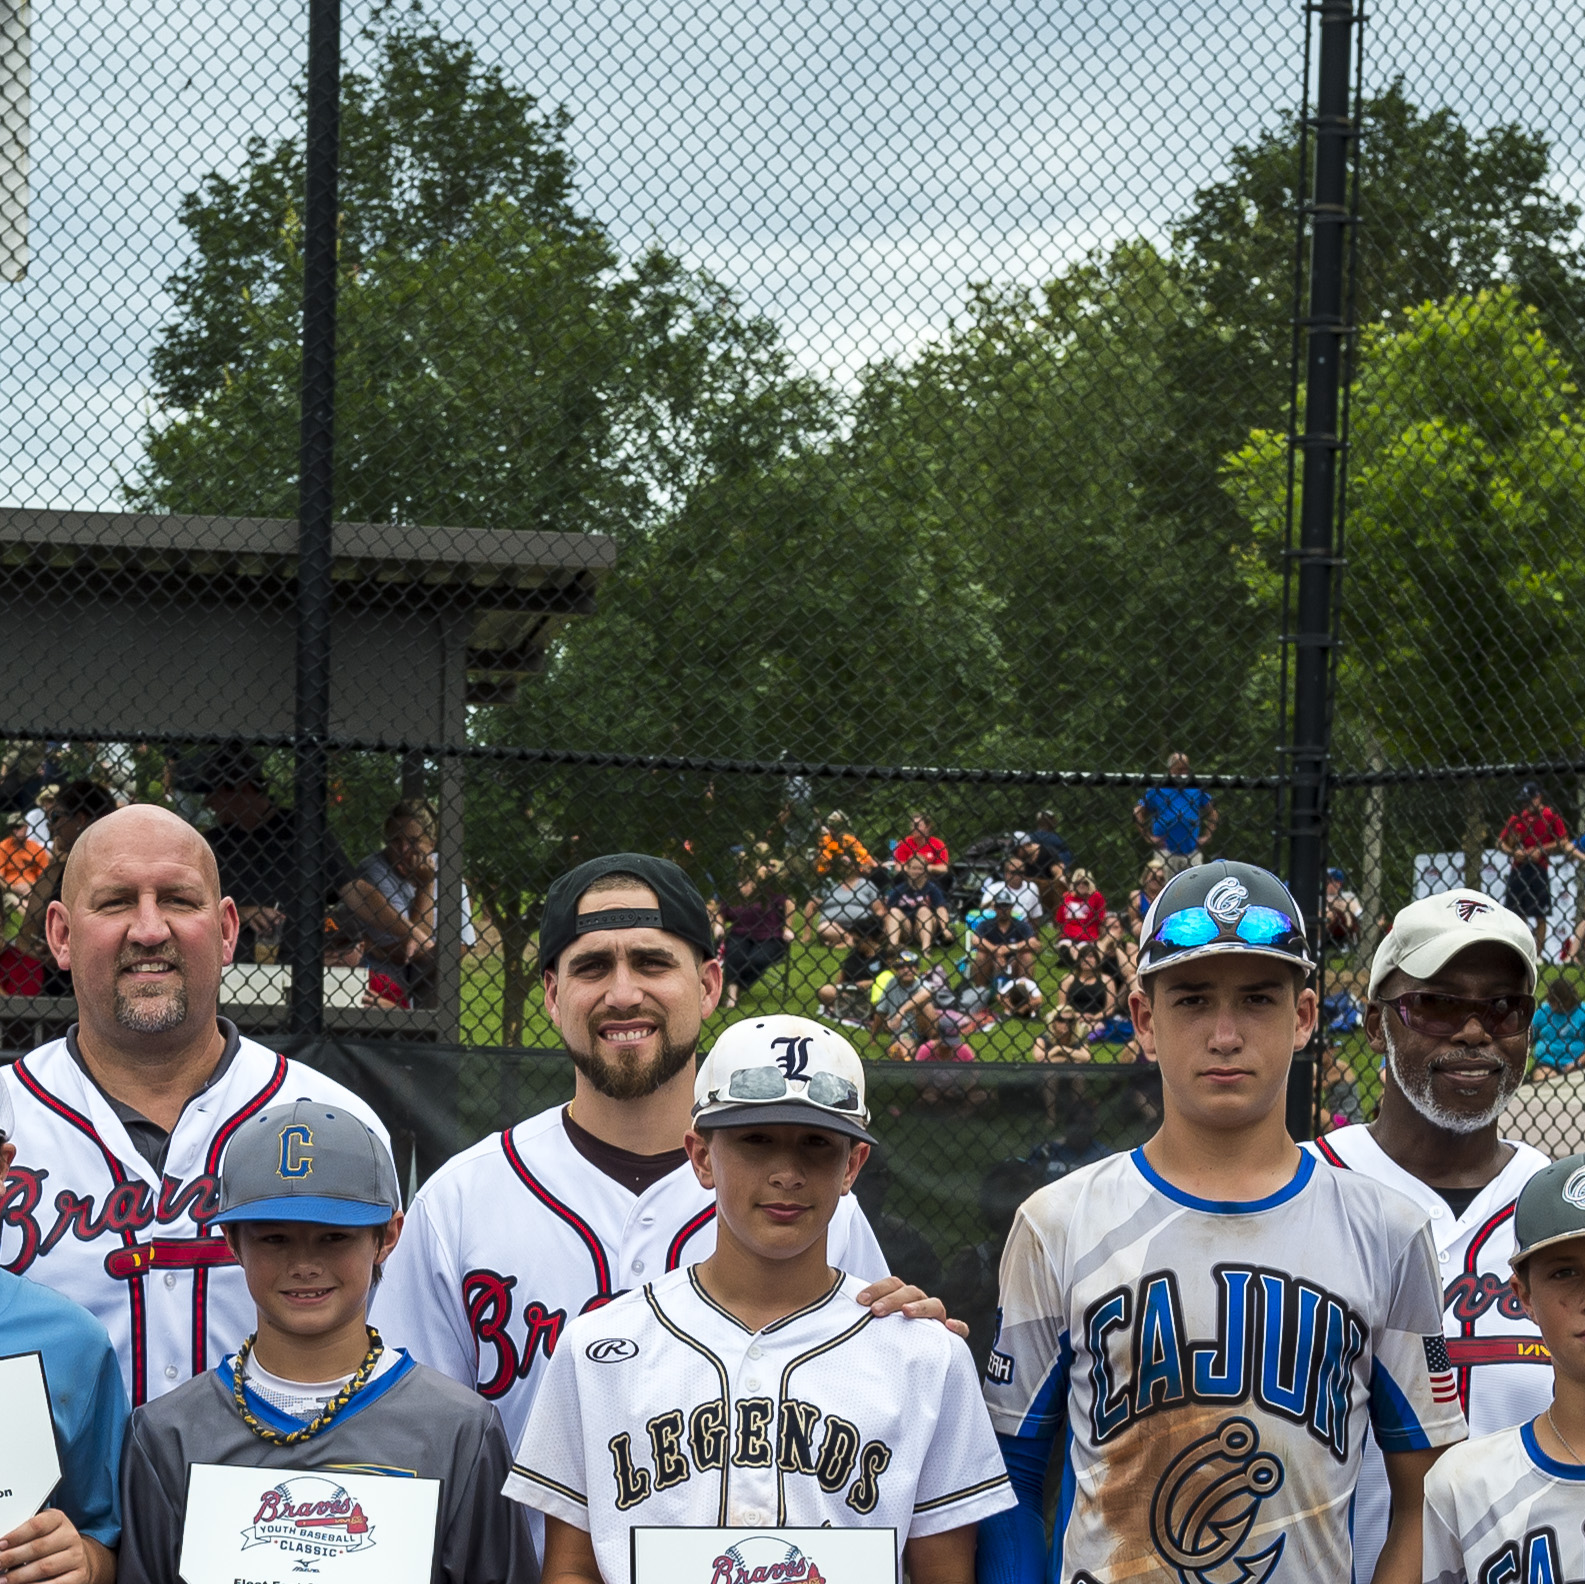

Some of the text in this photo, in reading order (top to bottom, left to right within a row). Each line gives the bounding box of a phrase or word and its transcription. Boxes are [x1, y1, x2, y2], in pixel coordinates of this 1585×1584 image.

[275, 1123, 314, 1180] C
[1083, 1260, 1370, 1463] CAJUN
[608, 1397, 893, 1516] LEGENDS
[254, 1490, 351, 1524] Braves
[280, 1540, 337, 1558] CLASSIC
